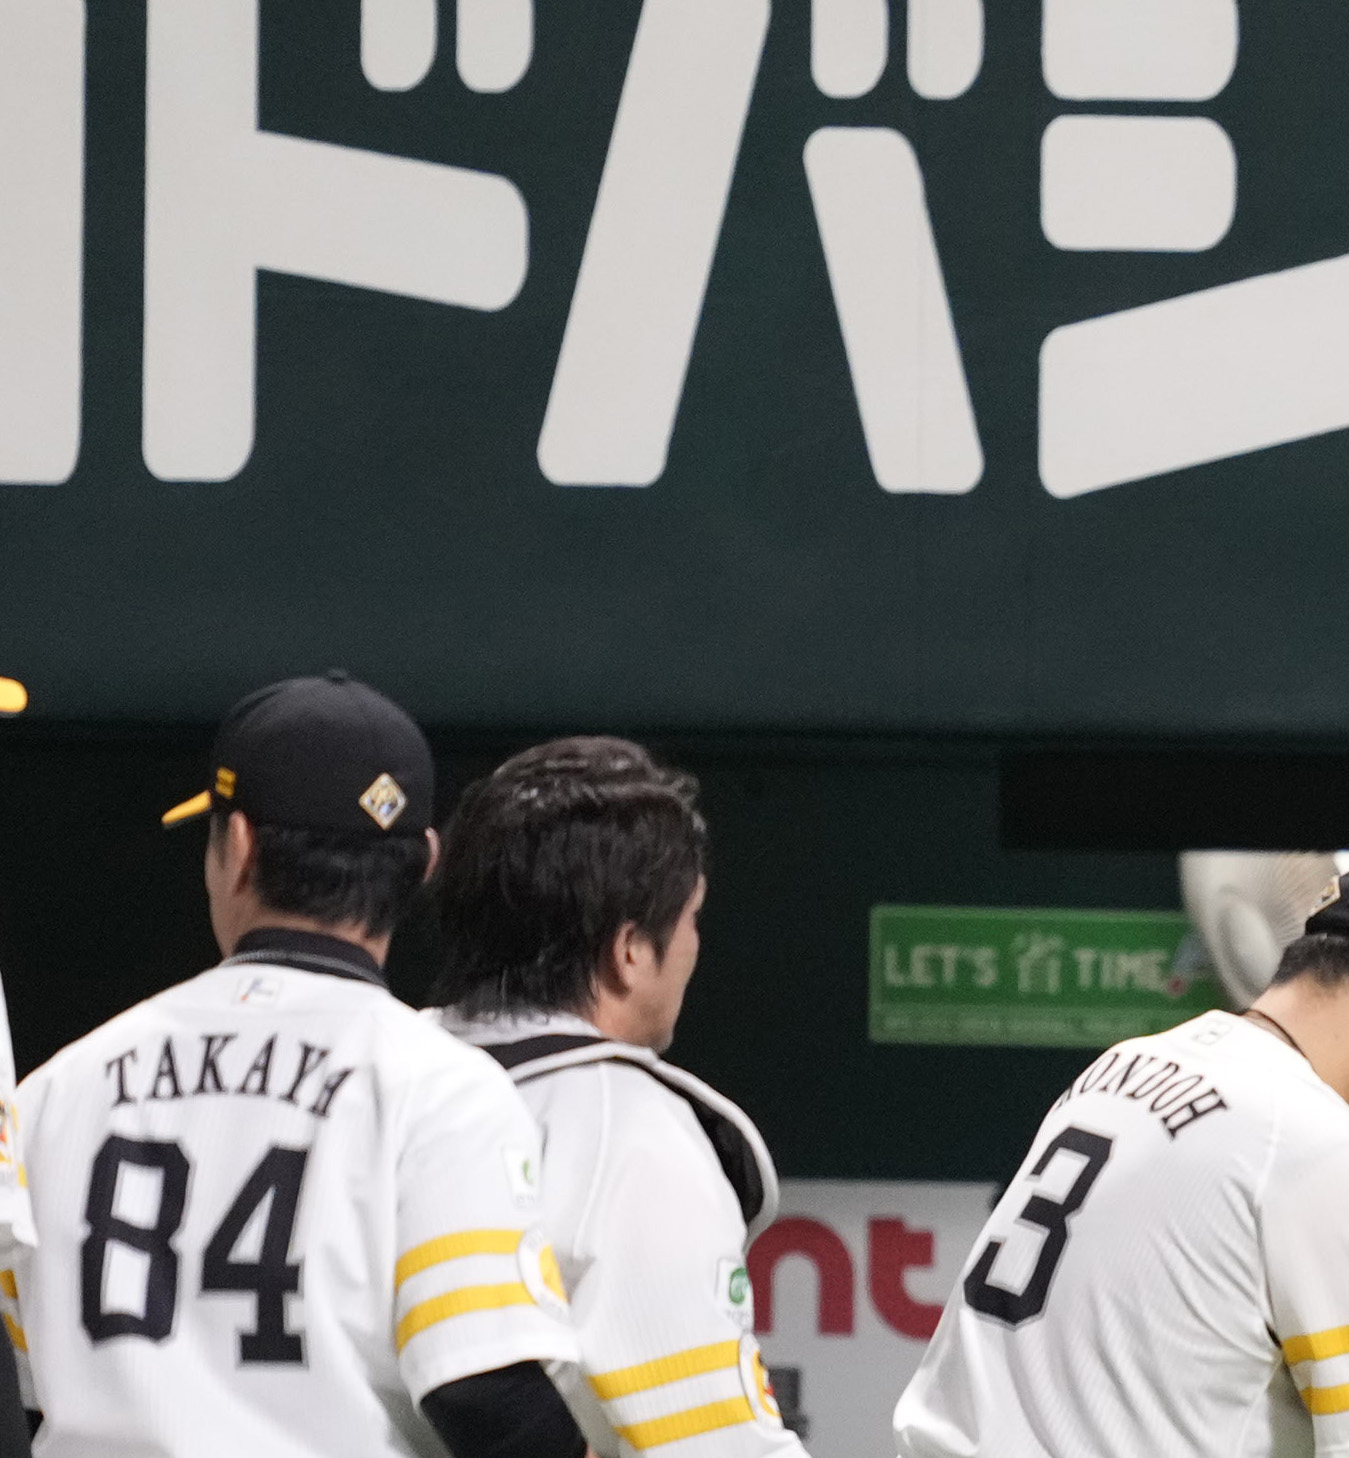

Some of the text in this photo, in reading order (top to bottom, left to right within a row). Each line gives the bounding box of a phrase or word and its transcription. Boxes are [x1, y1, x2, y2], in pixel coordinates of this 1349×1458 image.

[105, 1032, 356, 1120] TAKAYA
[80, 1134, 312, 1368] 84
[962, 1126, 1115, 1331] 3
